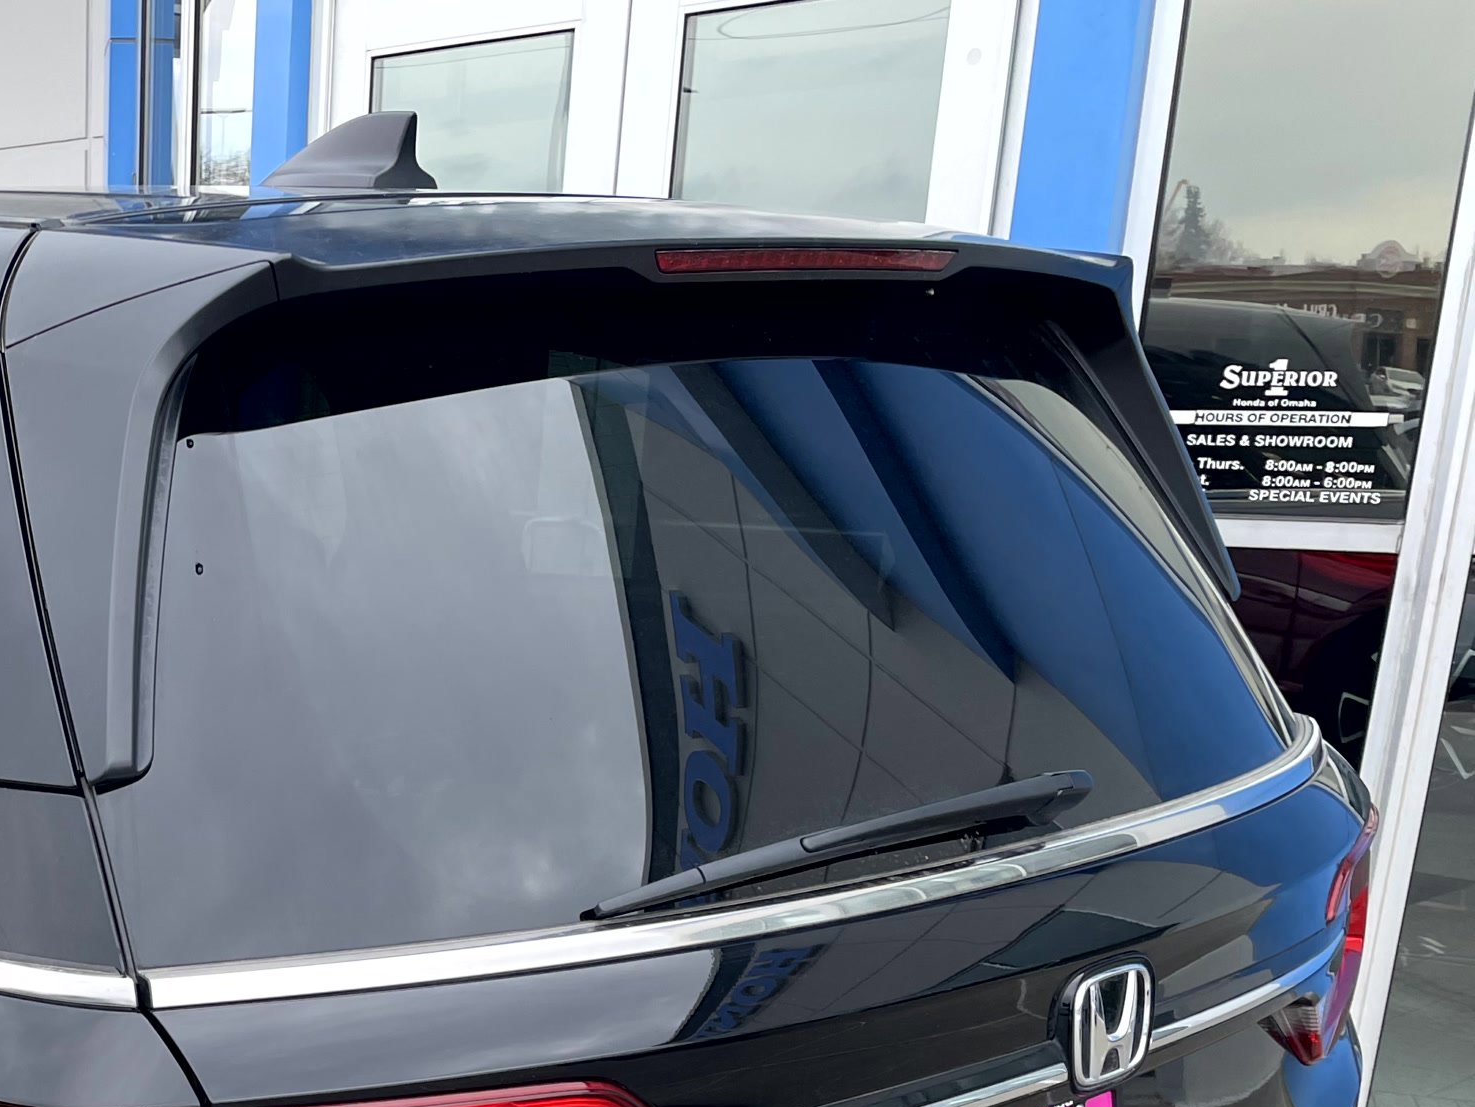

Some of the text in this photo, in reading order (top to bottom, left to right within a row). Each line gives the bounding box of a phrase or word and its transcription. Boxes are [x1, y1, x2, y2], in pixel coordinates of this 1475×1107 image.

[1232, 399, 1317, 408] Honda of Omaha
[1195, 412, 1352, 425] HOURS OF OPERATION
[1186, 433, 1354, 449] SALES & SHOWROOM
[1197, 456, 1245, 471] Thurs.
[1248, 489, 1382, 505] SPECIAL EVENTS
